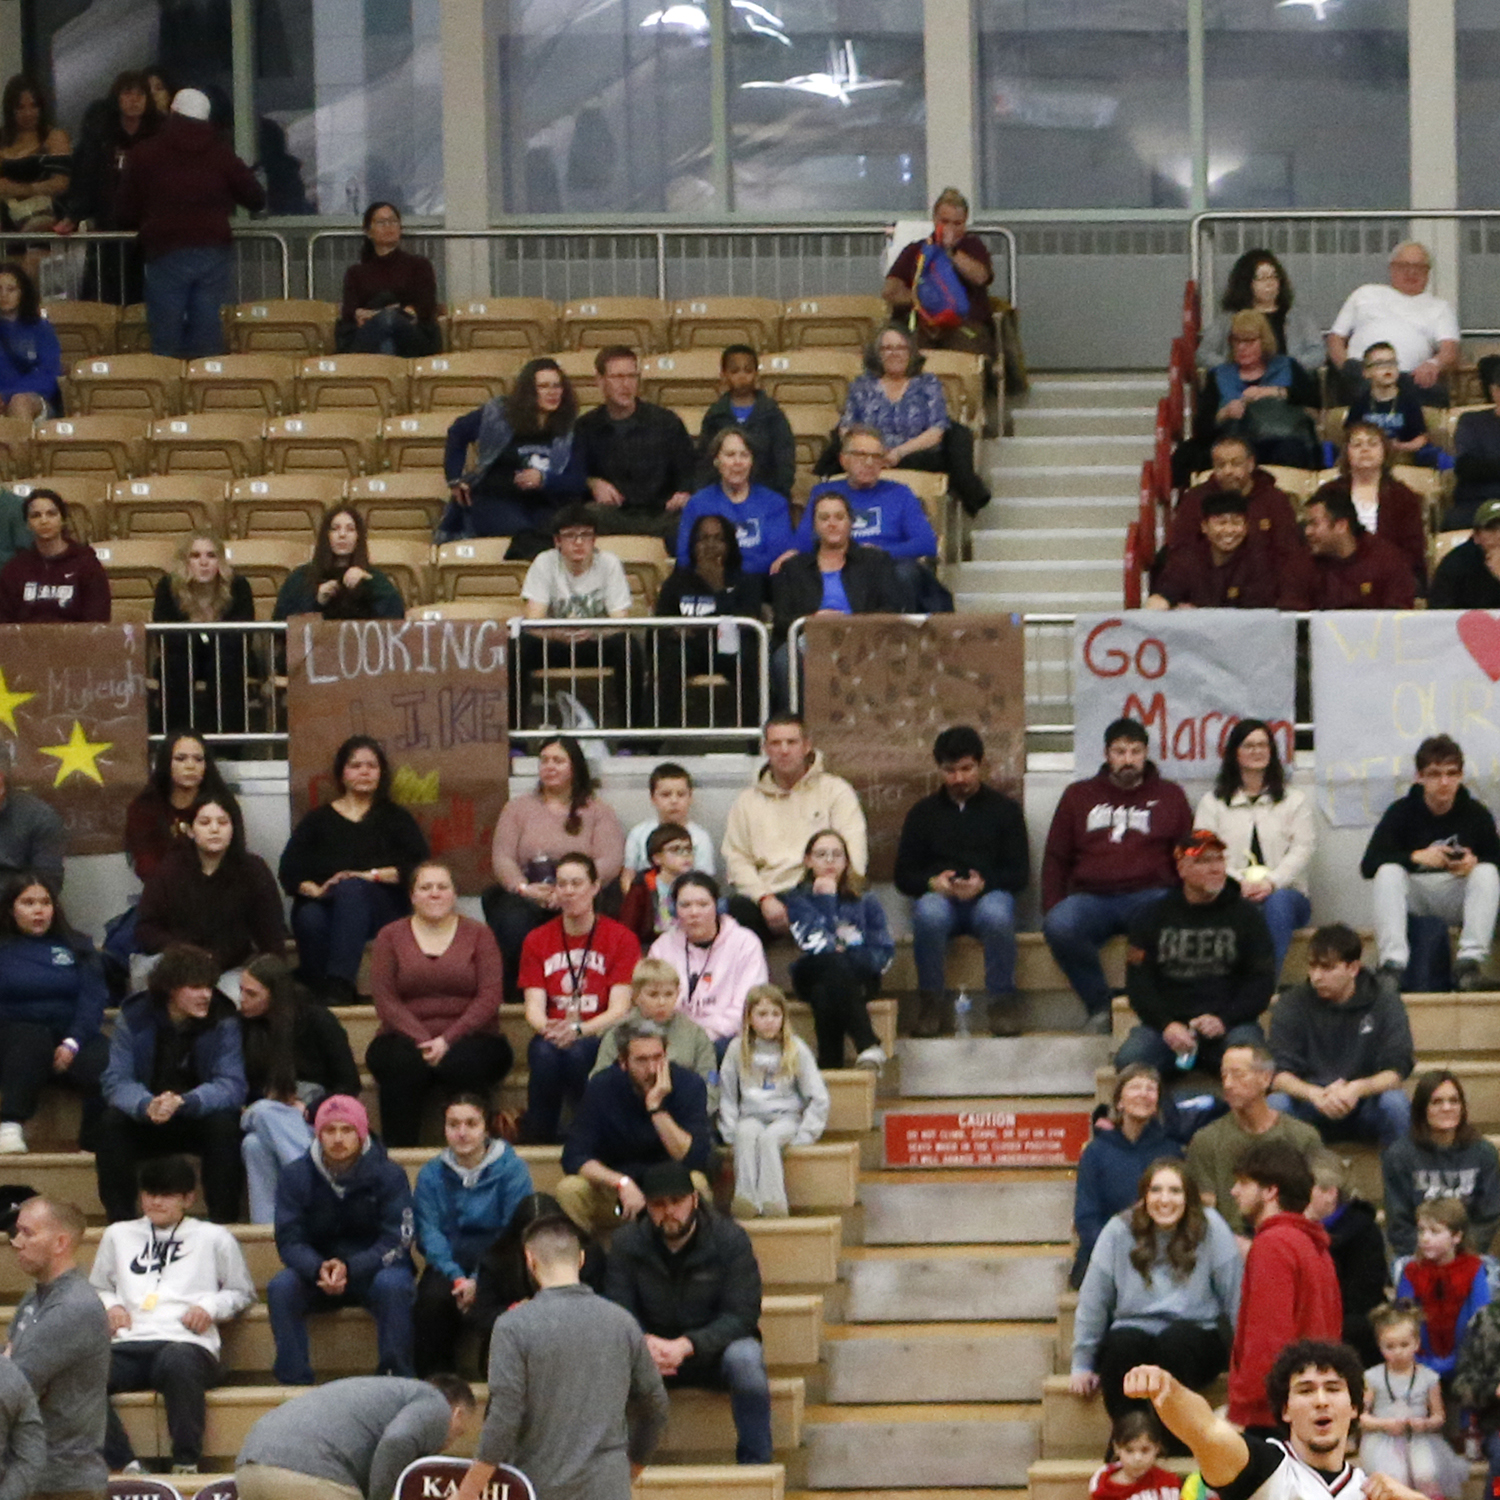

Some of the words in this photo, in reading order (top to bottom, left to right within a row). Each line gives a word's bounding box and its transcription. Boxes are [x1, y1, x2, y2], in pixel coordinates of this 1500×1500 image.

[304, 620, 506, 684] LOOKING
[1083, 618, 1168, 679] Go
[1325, 611, 1429, 665] WE
[958, 1113, 1016, 1129] CAUTION
